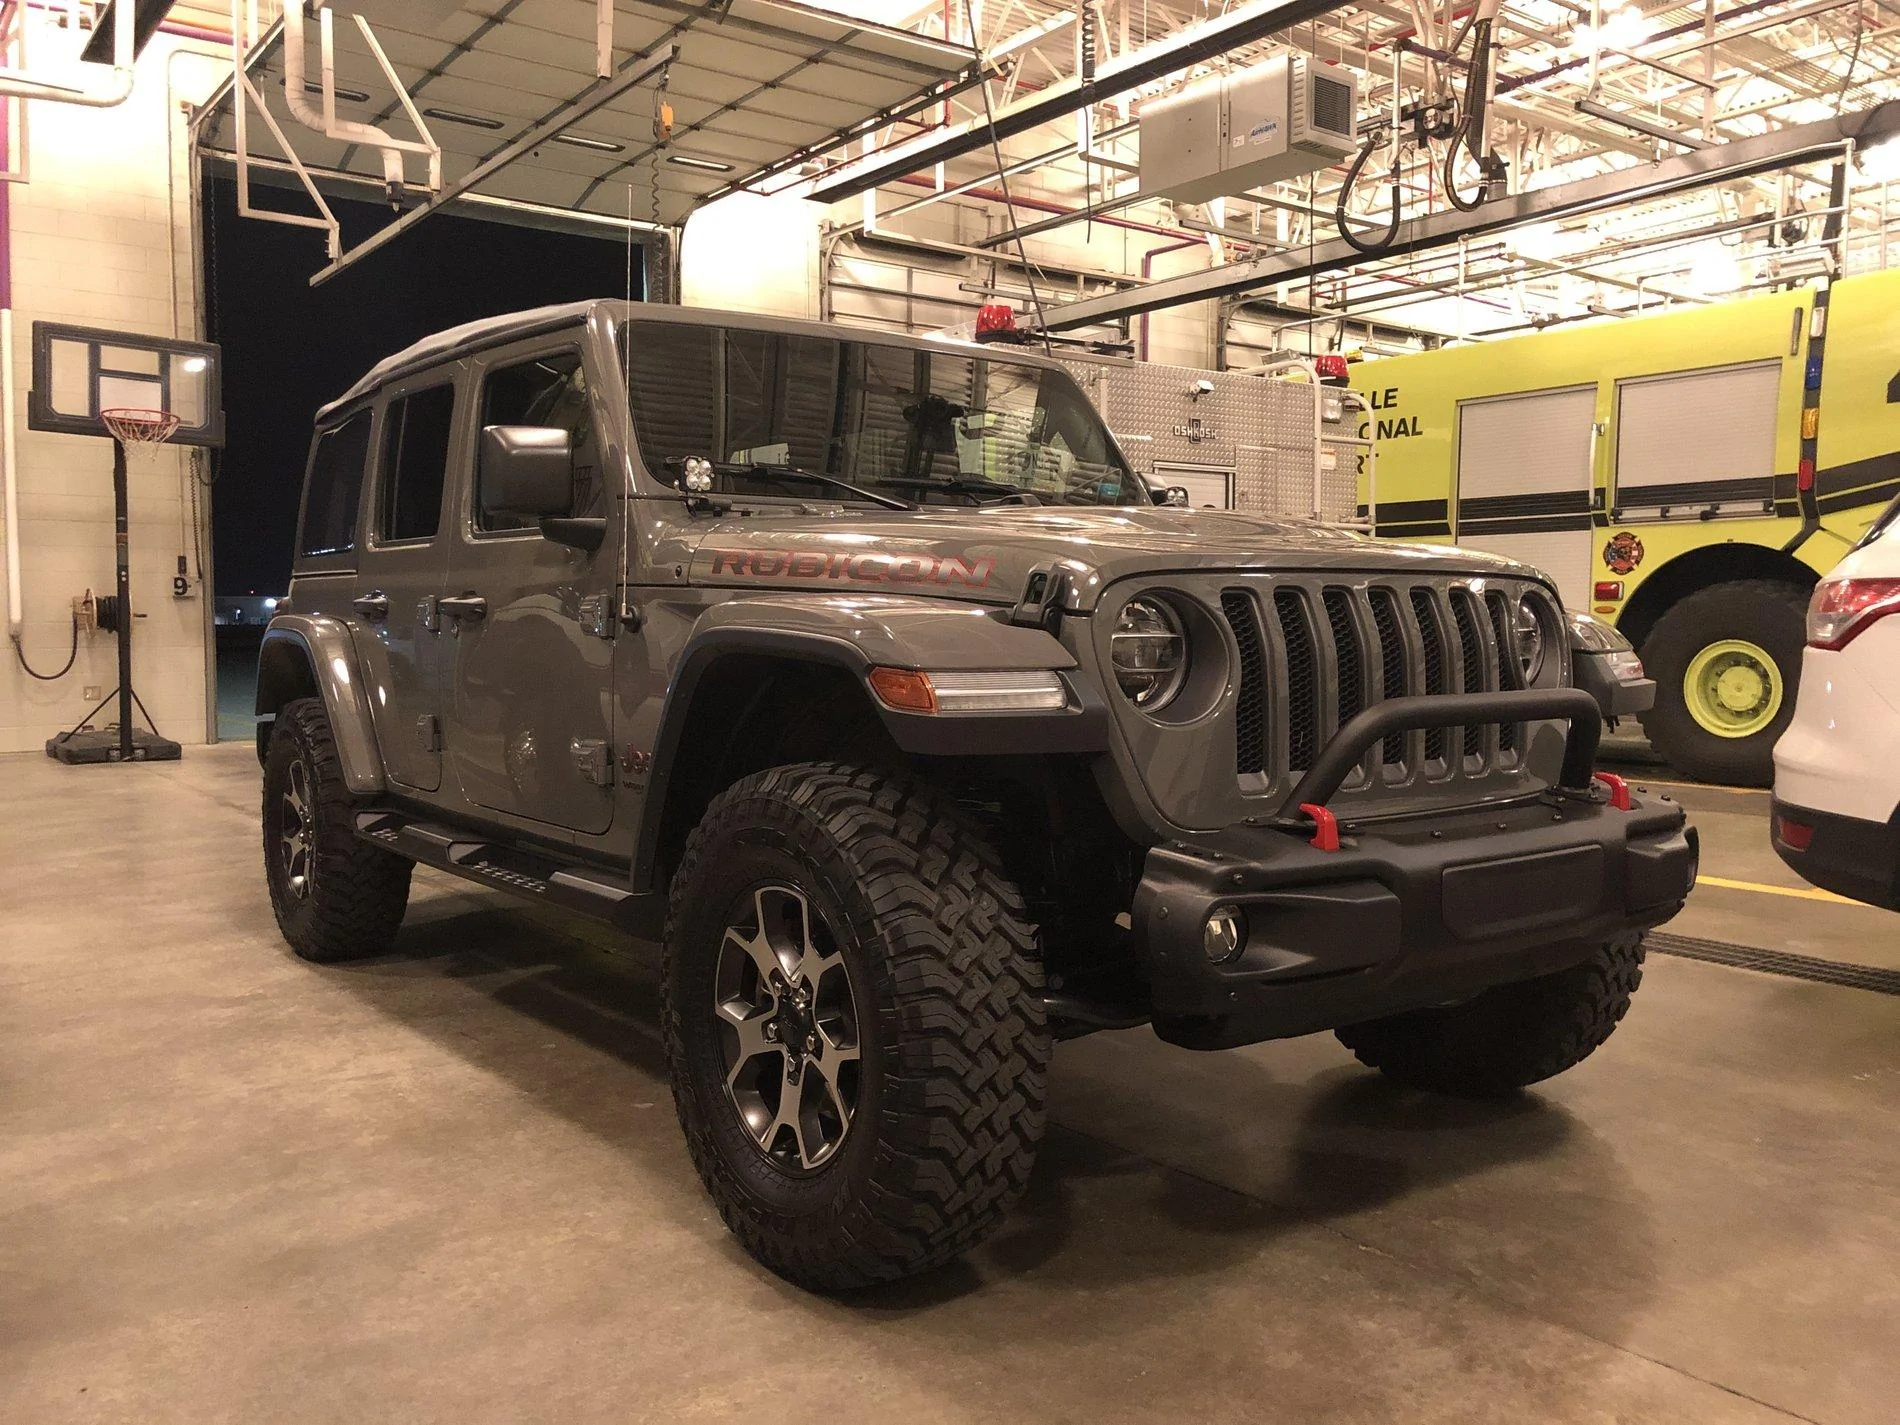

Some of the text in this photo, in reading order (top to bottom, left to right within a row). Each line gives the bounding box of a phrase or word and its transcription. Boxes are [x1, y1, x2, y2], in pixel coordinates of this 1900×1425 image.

[1173, 419, 1216, 442] OSHKOSH
[711, 550, 997, 588] RUBICON
[173, 577, 188, 596] 9
